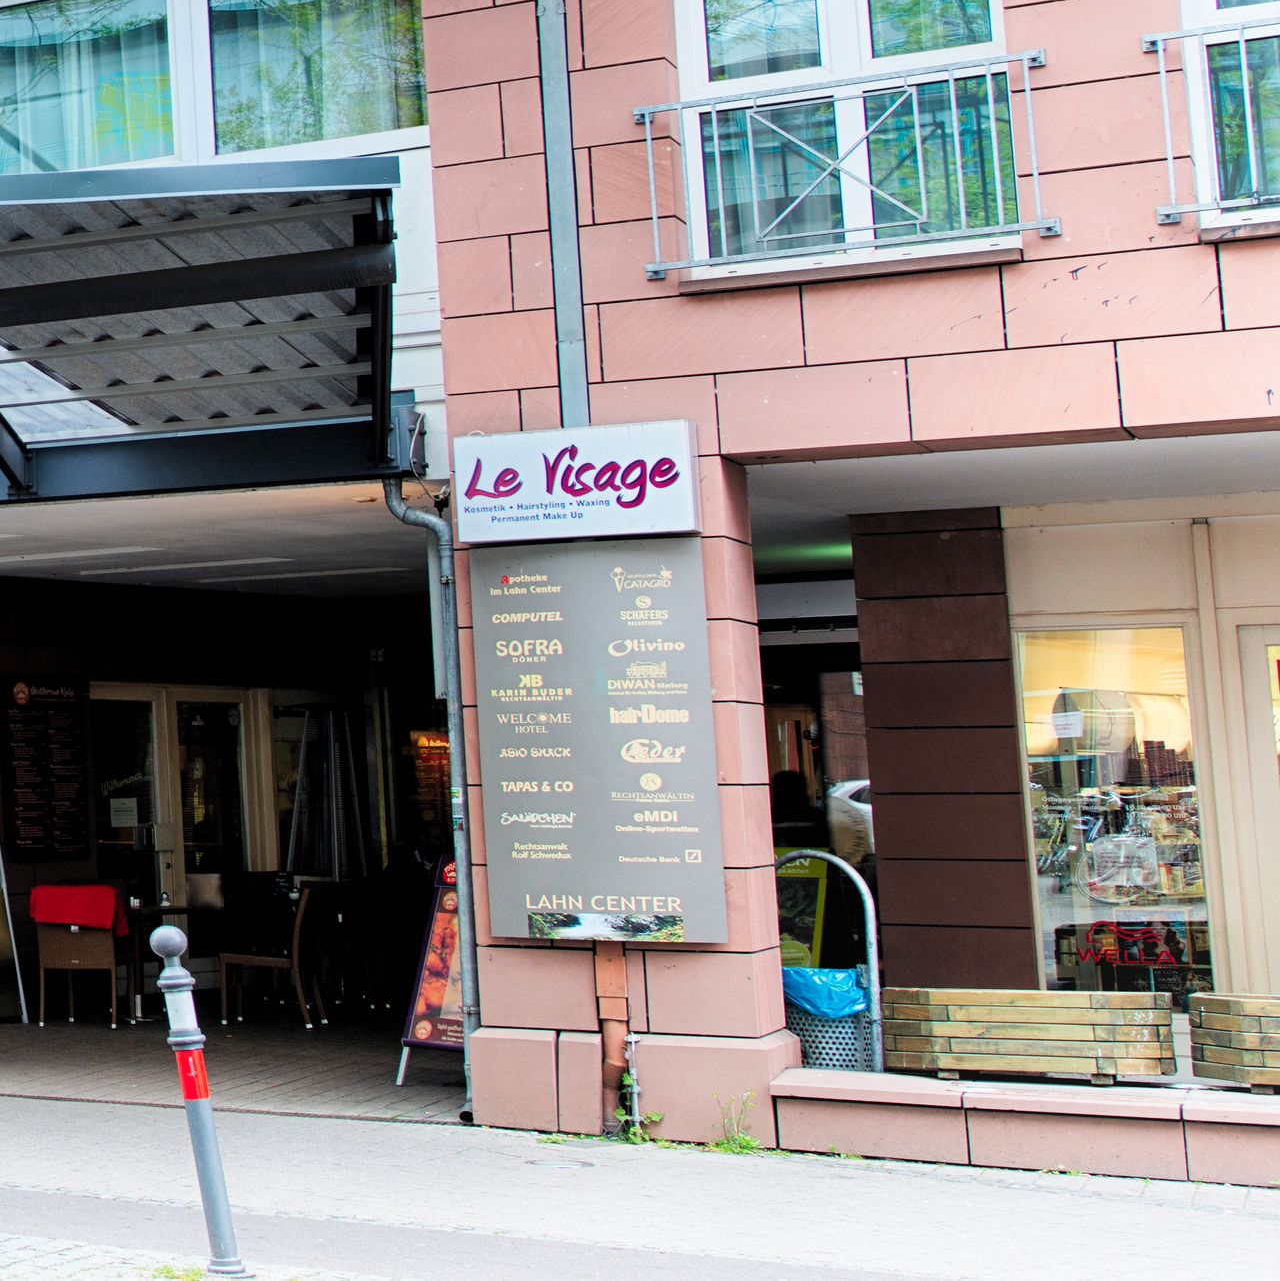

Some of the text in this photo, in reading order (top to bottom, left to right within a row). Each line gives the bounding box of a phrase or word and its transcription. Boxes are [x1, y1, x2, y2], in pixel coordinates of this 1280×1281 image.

[464, 444, 681, 509] Le Visage
[463, 498, 610, 514] Kosmetik Hairstyling Waxing
[491, 511, 583, 523] Permanent Make Up
[500, 574, 548, 585] Apotheke
[504, 587, 527, 595] Lahn
[530, 585, 561, 594] Center
[492, 611, 563, 624] COMPUTEL
[495, 639, 564, 657] SOFRA
[608, 638, 686, 657] Olivino
[491, 688, 573, 697] KARIN BUDER
[515, 725, 549, 734] HOTEL
[530, 747, 571, 758] SNACK
[501, 781, 574, 793] TAPAS & CO
[615, 825, 699, 834] Online-Sportwetten
[525, 894, 682, 912] LAHN CENTER
[1076, 947, 1178, 965] WELLA
